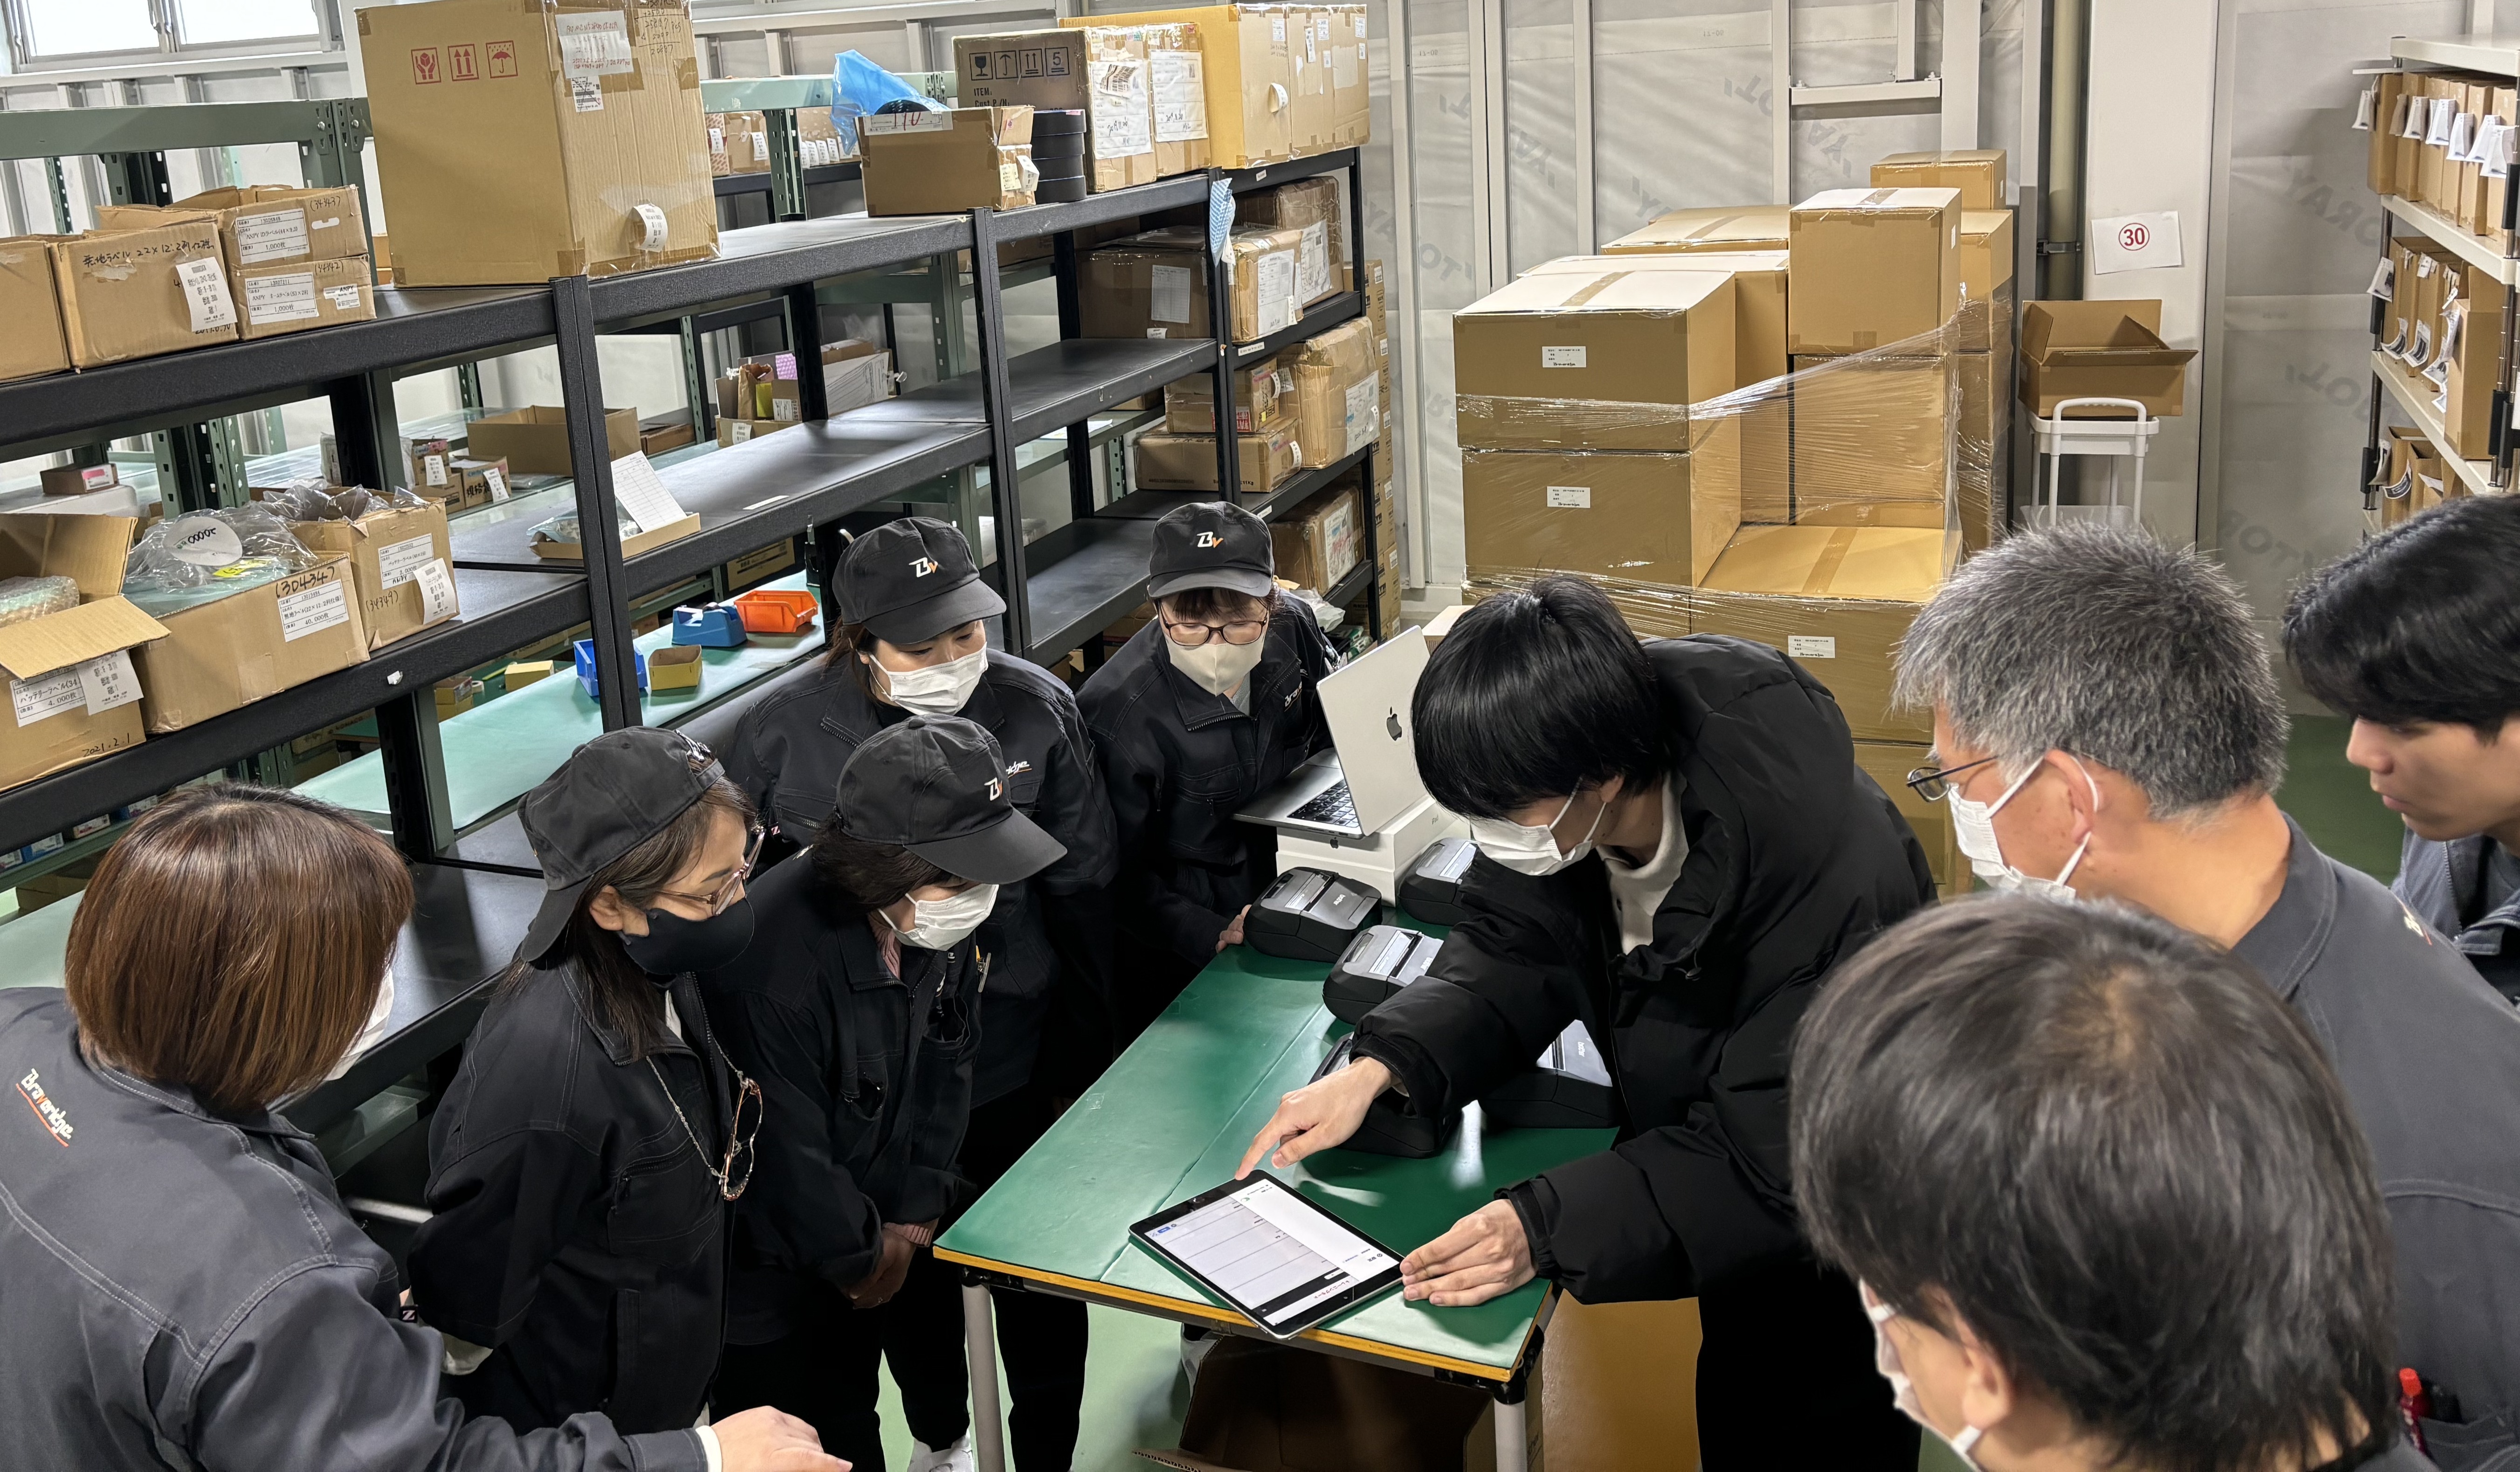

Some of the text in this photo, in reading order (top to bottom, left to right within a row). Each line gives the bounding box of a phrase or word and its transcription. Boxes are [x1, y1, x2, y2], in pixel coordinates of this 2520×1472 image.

[974, 88, 992, 96] ITEM:
[2124, 228, 2145, 246] 30
[21, 1068, 73, 1139] Braveridge
